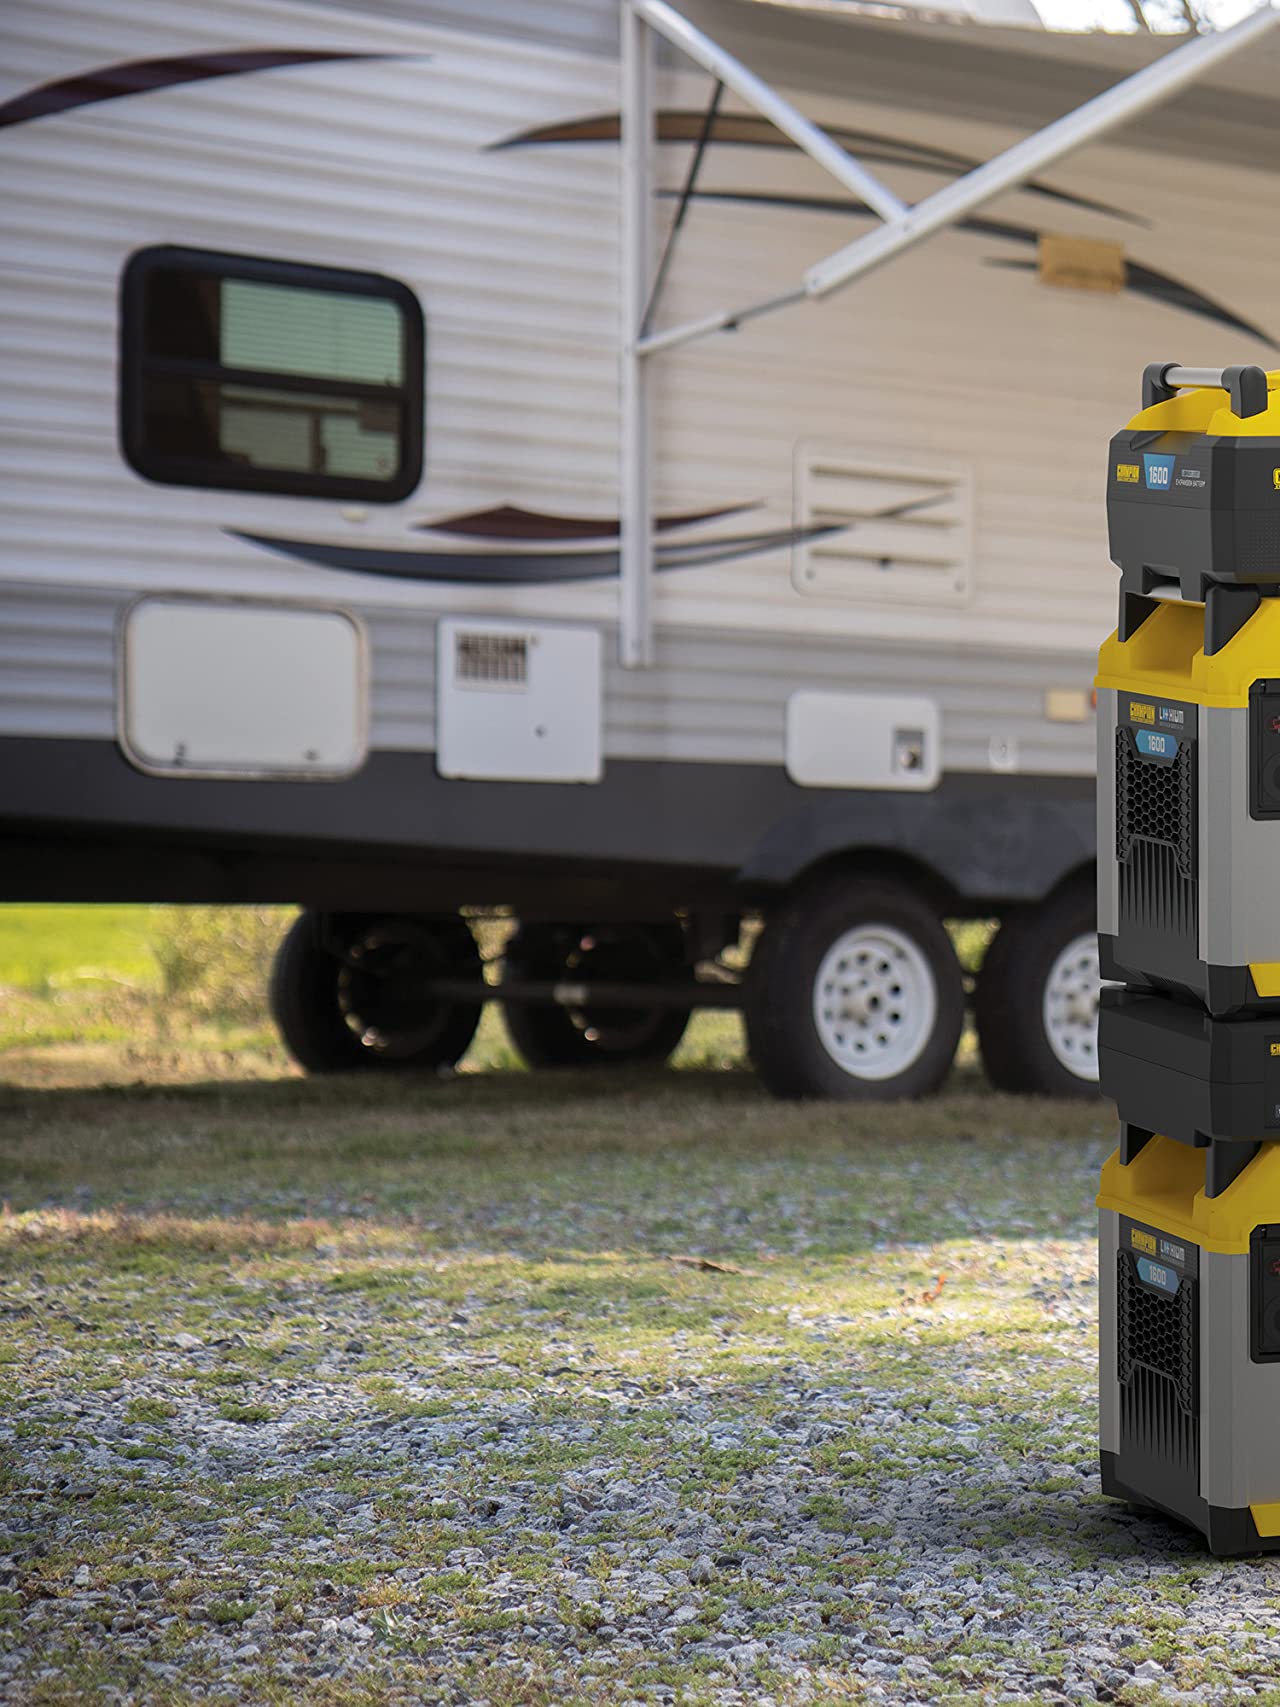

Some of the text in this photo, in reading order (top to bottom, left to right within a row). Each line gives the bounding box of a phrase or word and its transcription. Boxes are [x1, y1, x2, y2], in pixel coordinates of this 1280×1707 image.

[1149, 466, 1168, 484] 1600
[1148, 735, 1165, 752] 1600
[1150, 1265, 1166, 1286] 1600
